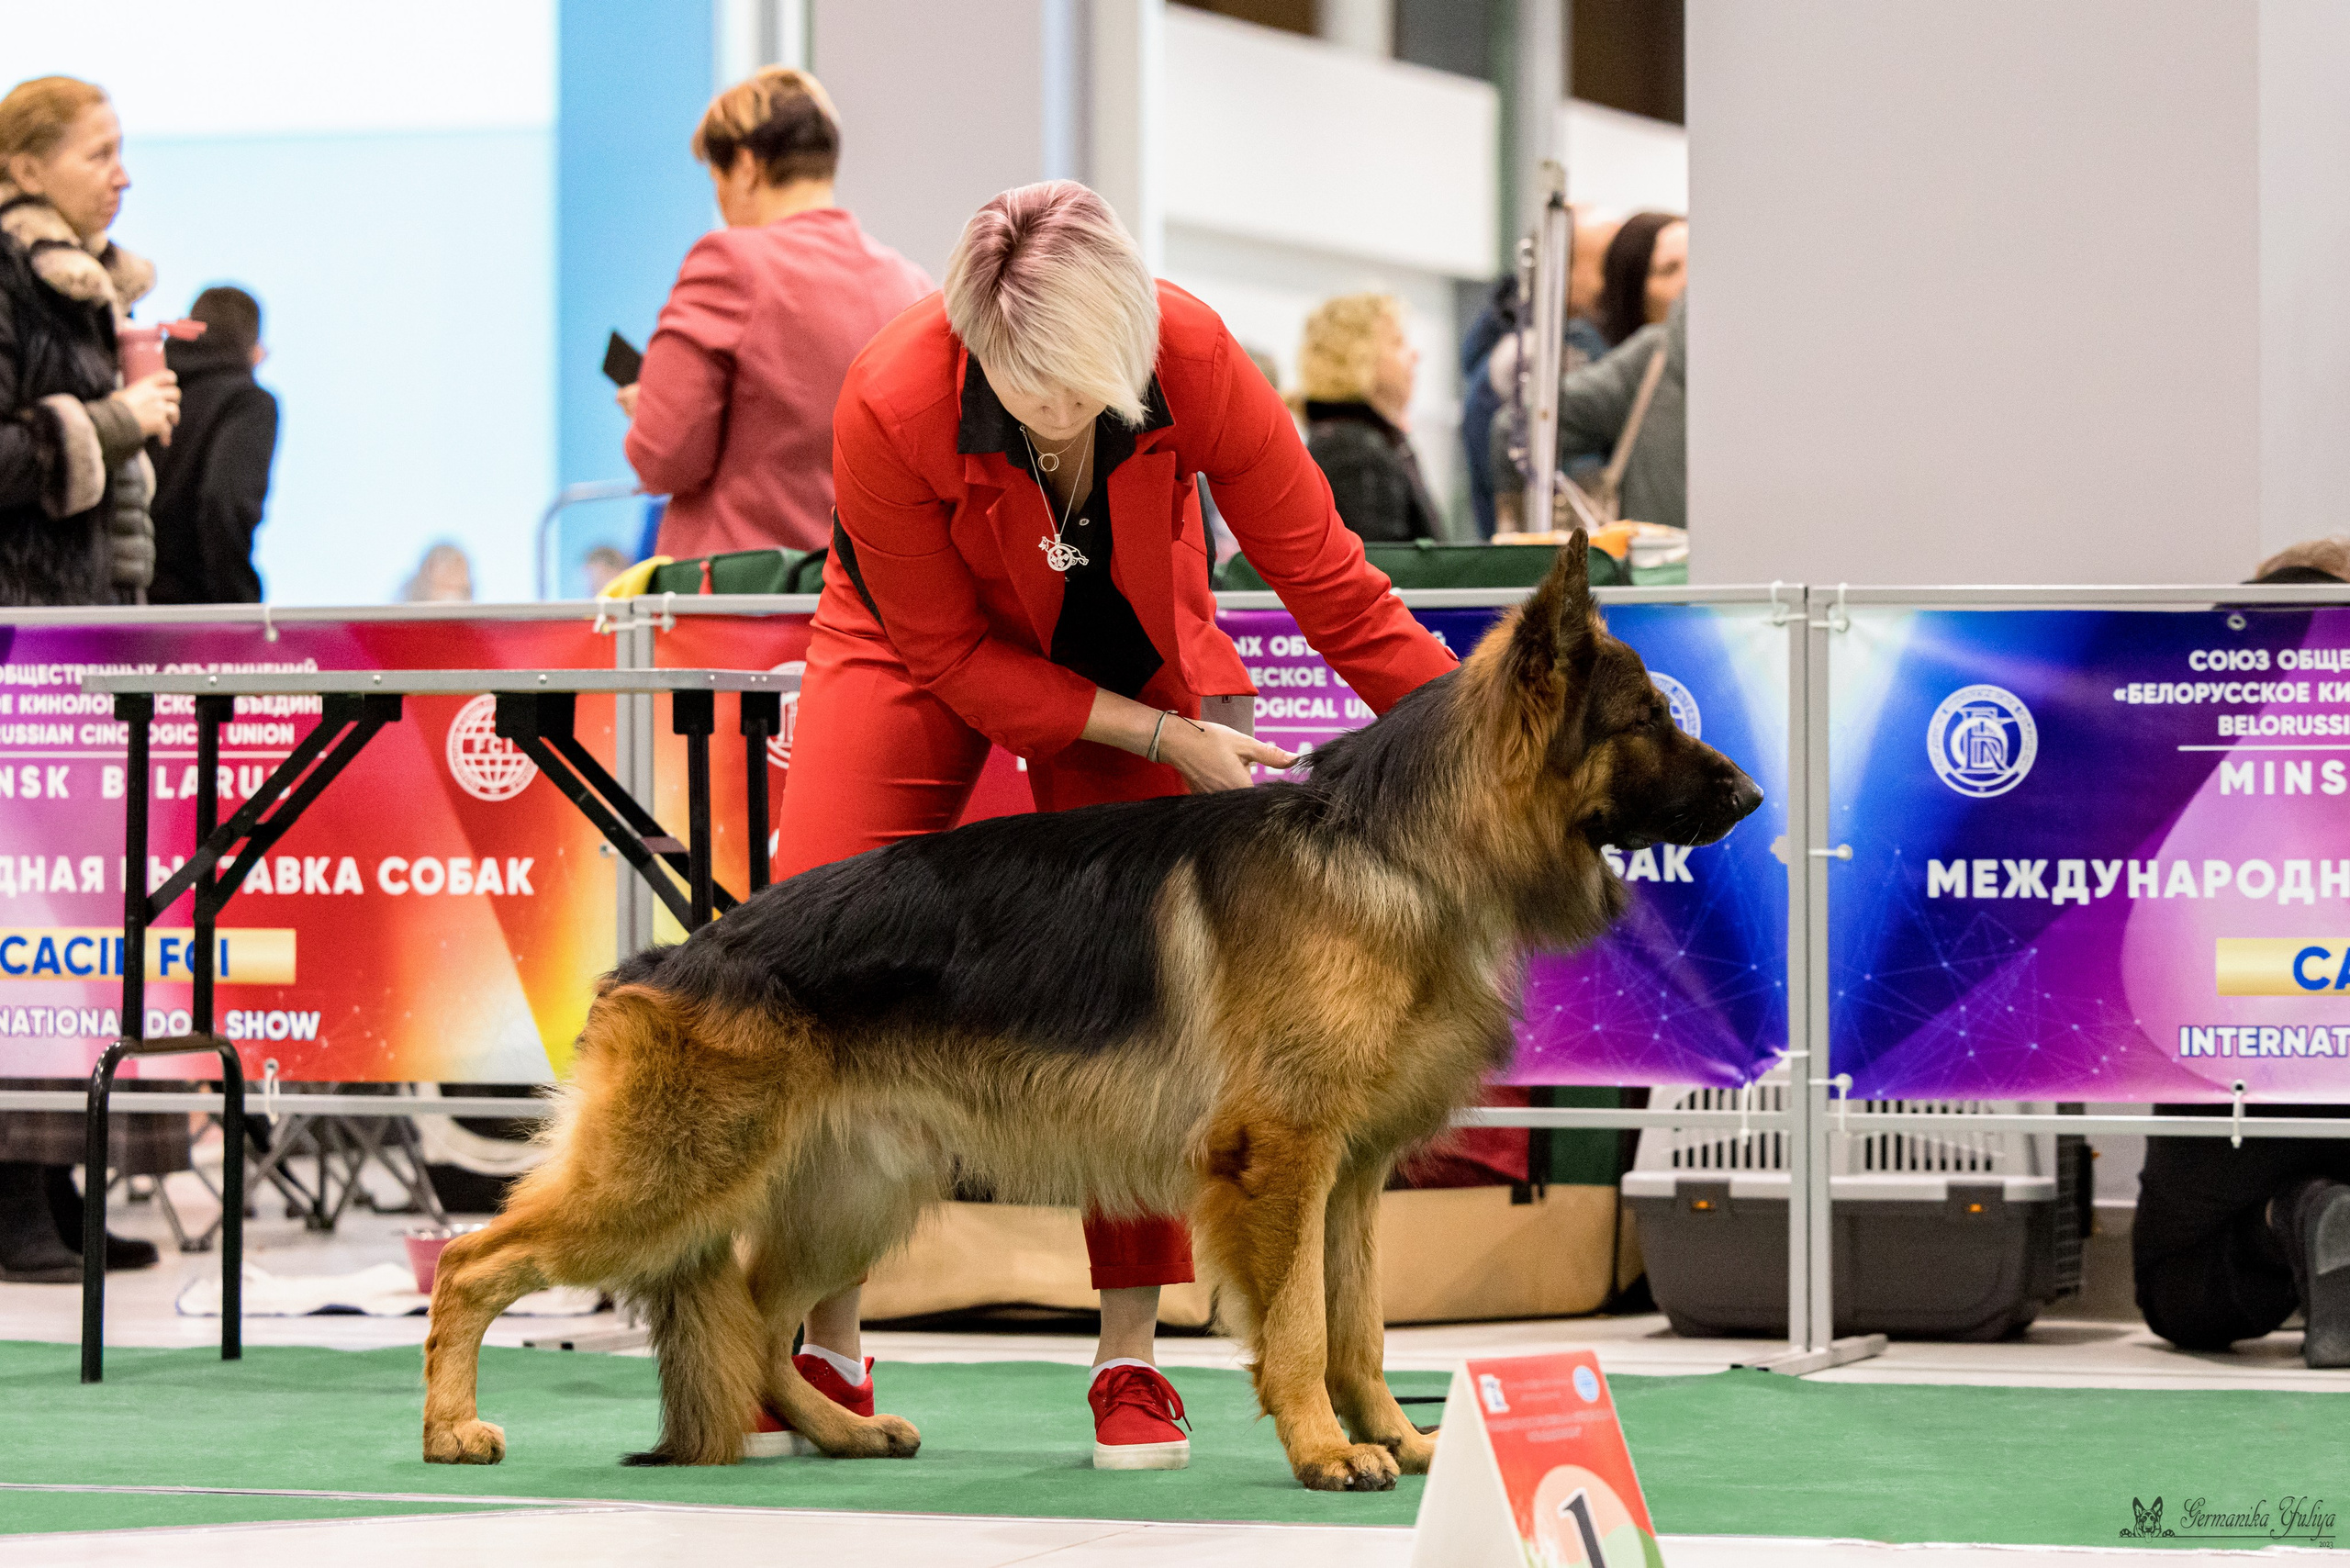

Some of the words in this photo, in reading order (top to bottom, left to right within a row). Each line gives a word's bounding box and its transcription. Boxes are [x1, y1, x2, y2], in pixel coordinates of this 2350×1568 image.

[2188, 649, 2271, 671] СОЮЗ
[2277, 649, 2350, 673] ОБЩЕ
[2113, 682, 2311, 704] «БЕЛОРУССКОЕ
[0, 723, 74, 745] USSIAN
[227, 723, 295, 745] UNION
[2218, 714, 2350, 736] BELORUSSI
[102, 765, 292, 800] BLARU
[2220, 760, 2348, 796] MINS
[377, 856, 535, 896] СОБАК
[1928, 859, 2350, 905] МЕЖДУНАРОДН
[226, 1010, 321, 1041] SHOW
[2179, 1025, 2350, 1058] INTERNAT
[1558, 1488, 1606, 1568] 1
